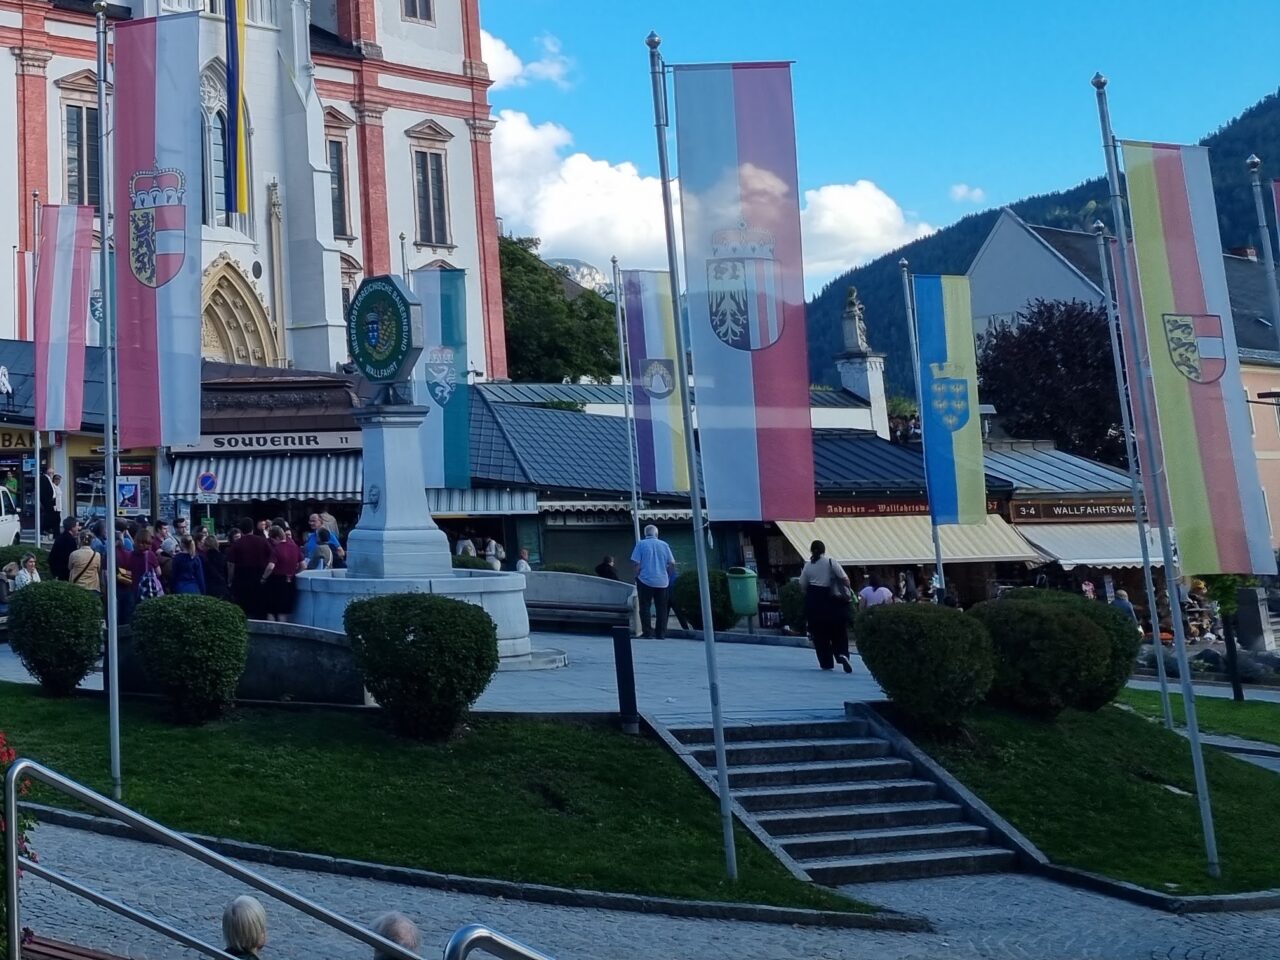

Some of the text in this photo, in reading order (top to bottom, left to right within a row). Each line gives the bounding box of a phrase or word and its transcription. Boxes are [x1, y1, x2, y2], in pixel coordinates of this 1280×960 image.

[365, 361, 399, 378] WALLFAHRT
[214, 434, 320, 448] SOUVENIR
[827, 504, 866, 514] Andenken
[1020, 507, 1036, 515] 3-4
